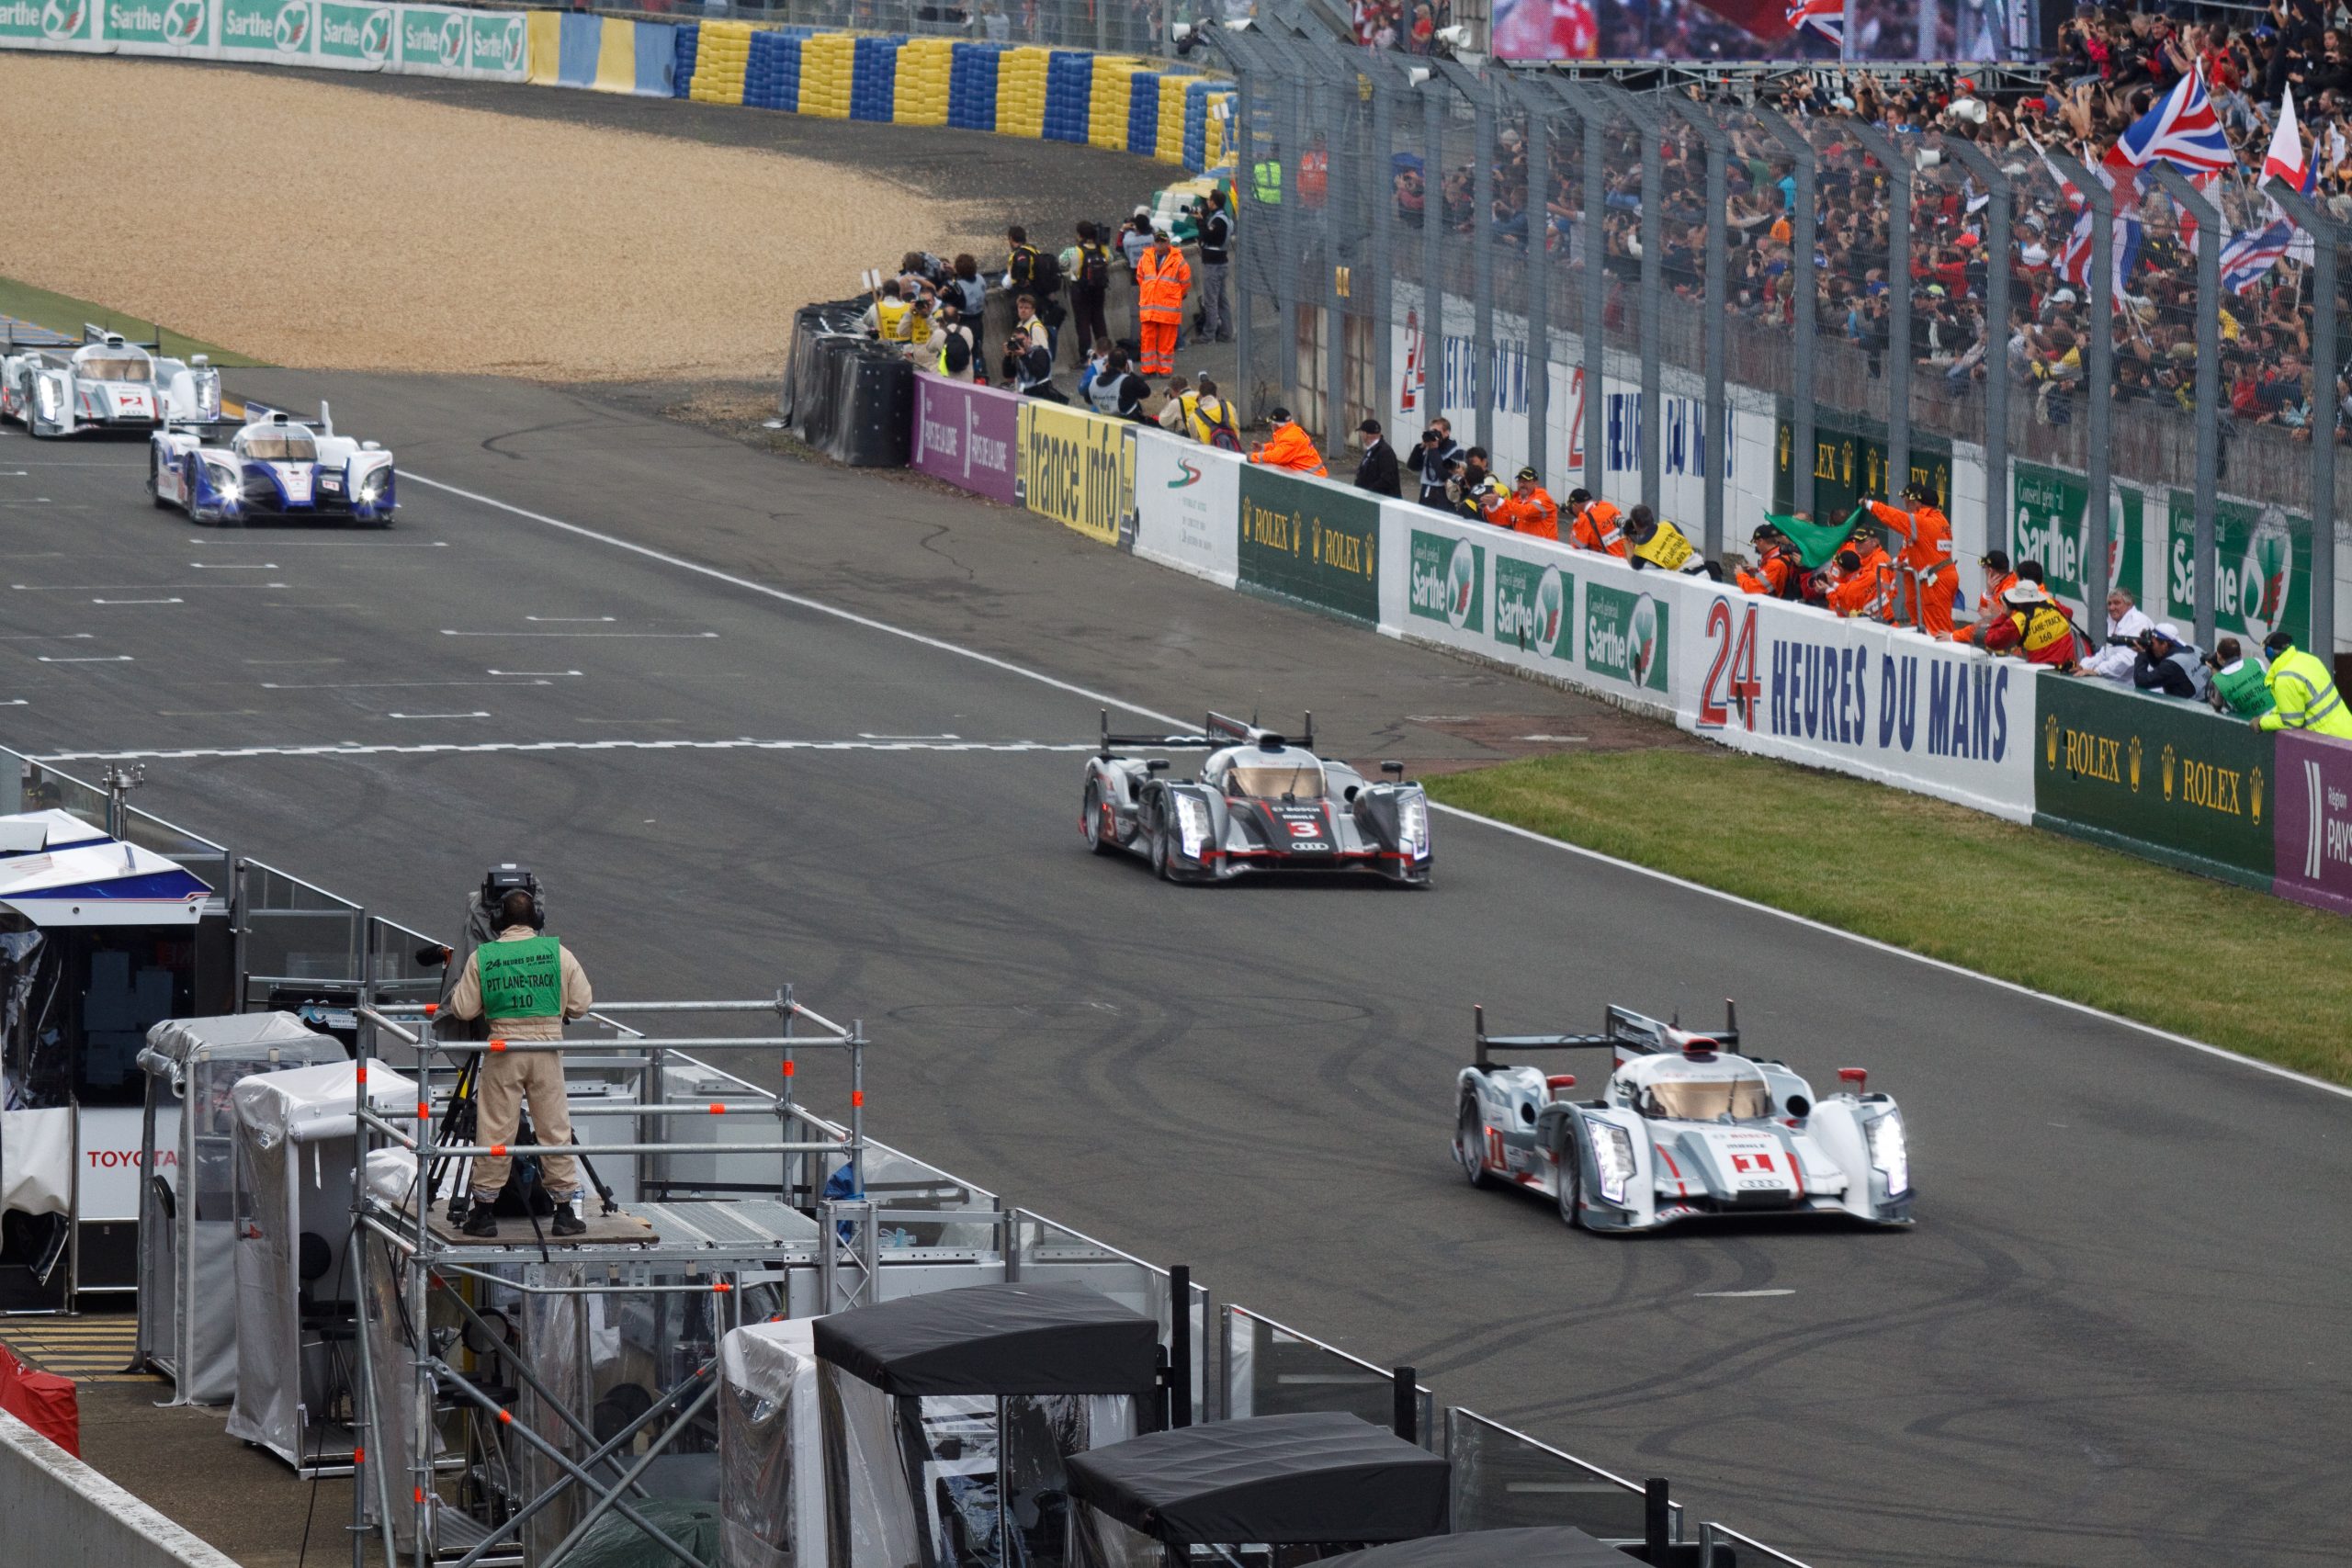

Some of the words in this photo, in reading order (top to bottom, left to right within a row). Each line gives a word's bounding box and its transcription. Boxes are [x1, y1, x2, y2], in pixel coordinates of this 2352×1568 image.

[0, 4, 40, 26] arthe
[110, 4, 162, 30] Sarthe
[227, 9, 274, 38] Sarthe
[324, 17, 359, 46] Sarthe
[406, 24, 438, 52] Sarthe
[474, 30, 502, 58] Sarthe
[1031, 405, 1079, 522] france
[1085, 418, 1116, 533] info
[1255, 507, 1288, 550] ROLEX
[1325, 529, 1360, 573] ROLEX
[1413, 561, 1445, 611] Sarthe
[2173, 538, 2237, 615] Sahe
[1498, 588, 1532, 639] Sarthe
[1589, 615, 1624, 669] Sarthe
[1696, 595, 1761, 732] 24
[1771, 640, 1867, 746] HEURES
[1879, 653, 1917, 751] DU
[1928, 659, 2008, 763] MANS
[2066, 729, 2120, 783] ROLEX
[2183, 759, 2241, 815] ROLEX
[2328, 786, 2346, 811] Région
[1107, 807, 1114, 837] 3
[1291, 821, 1318, 837] 3
[485, 959, 502, 971] 24
[503, 958, 524, 966] HEURES
[487, 977, 501, 992] PIT
[503, 974, 554, 989] LANE-TRACK
[511, 995, 533, 1008] 110
[1736, 1155, 1772, 1173] 1
